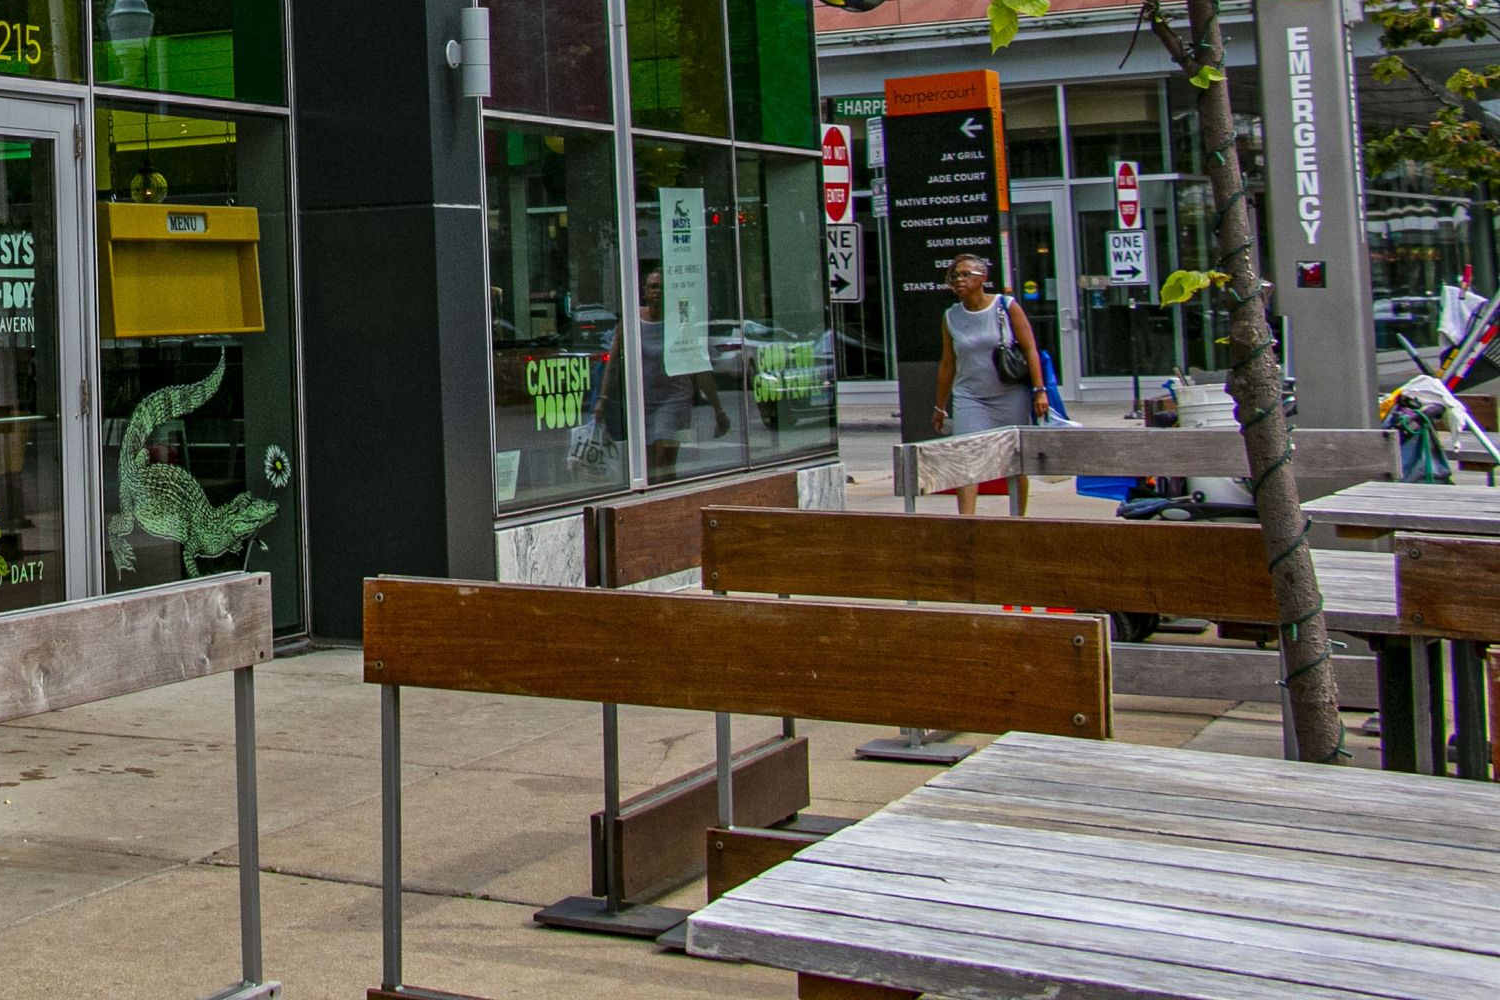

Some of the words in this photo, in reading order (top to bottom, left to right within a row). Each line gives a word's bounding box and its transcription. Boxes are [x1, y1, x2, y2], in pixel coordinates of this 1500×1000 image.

[894, 83, 977, 109] harpercourt
[837, 103, 843, 113] E
[844, 100, 887, 115] HARPE
[1286, 27, 1318, 244] EMERGENCY
[957, 151, 985, 160] GRILL
[928, 174, 952, 184] JADE
[954, 172, 986, 182] COURT
[826, 188, 845, 203] ENTER
[896, 197, 928, 207] NATIVE
[929, 195, 960, 205] FOODS
[170, 216, 198, 231] MENU
[901, 217, 944, 228] CONNECT
[946, 214, 989, 225] GALLERY
[828, 230, 852, 248] NE
[926, 237, 954, 248] SUURI
[956, 235, 992, 246] DESIGN
[1112, 235, 1142, 248] ONE
[829, 252, 853, 269] AY
[1112, 251, 1142, 263] WAY
[903, 282, 934, 292] STAN'S
[526, 356, 591, 396] CATFISH
[535, 392, 584, 431] POBOY
[11, 560, 44, 585] DAT?
